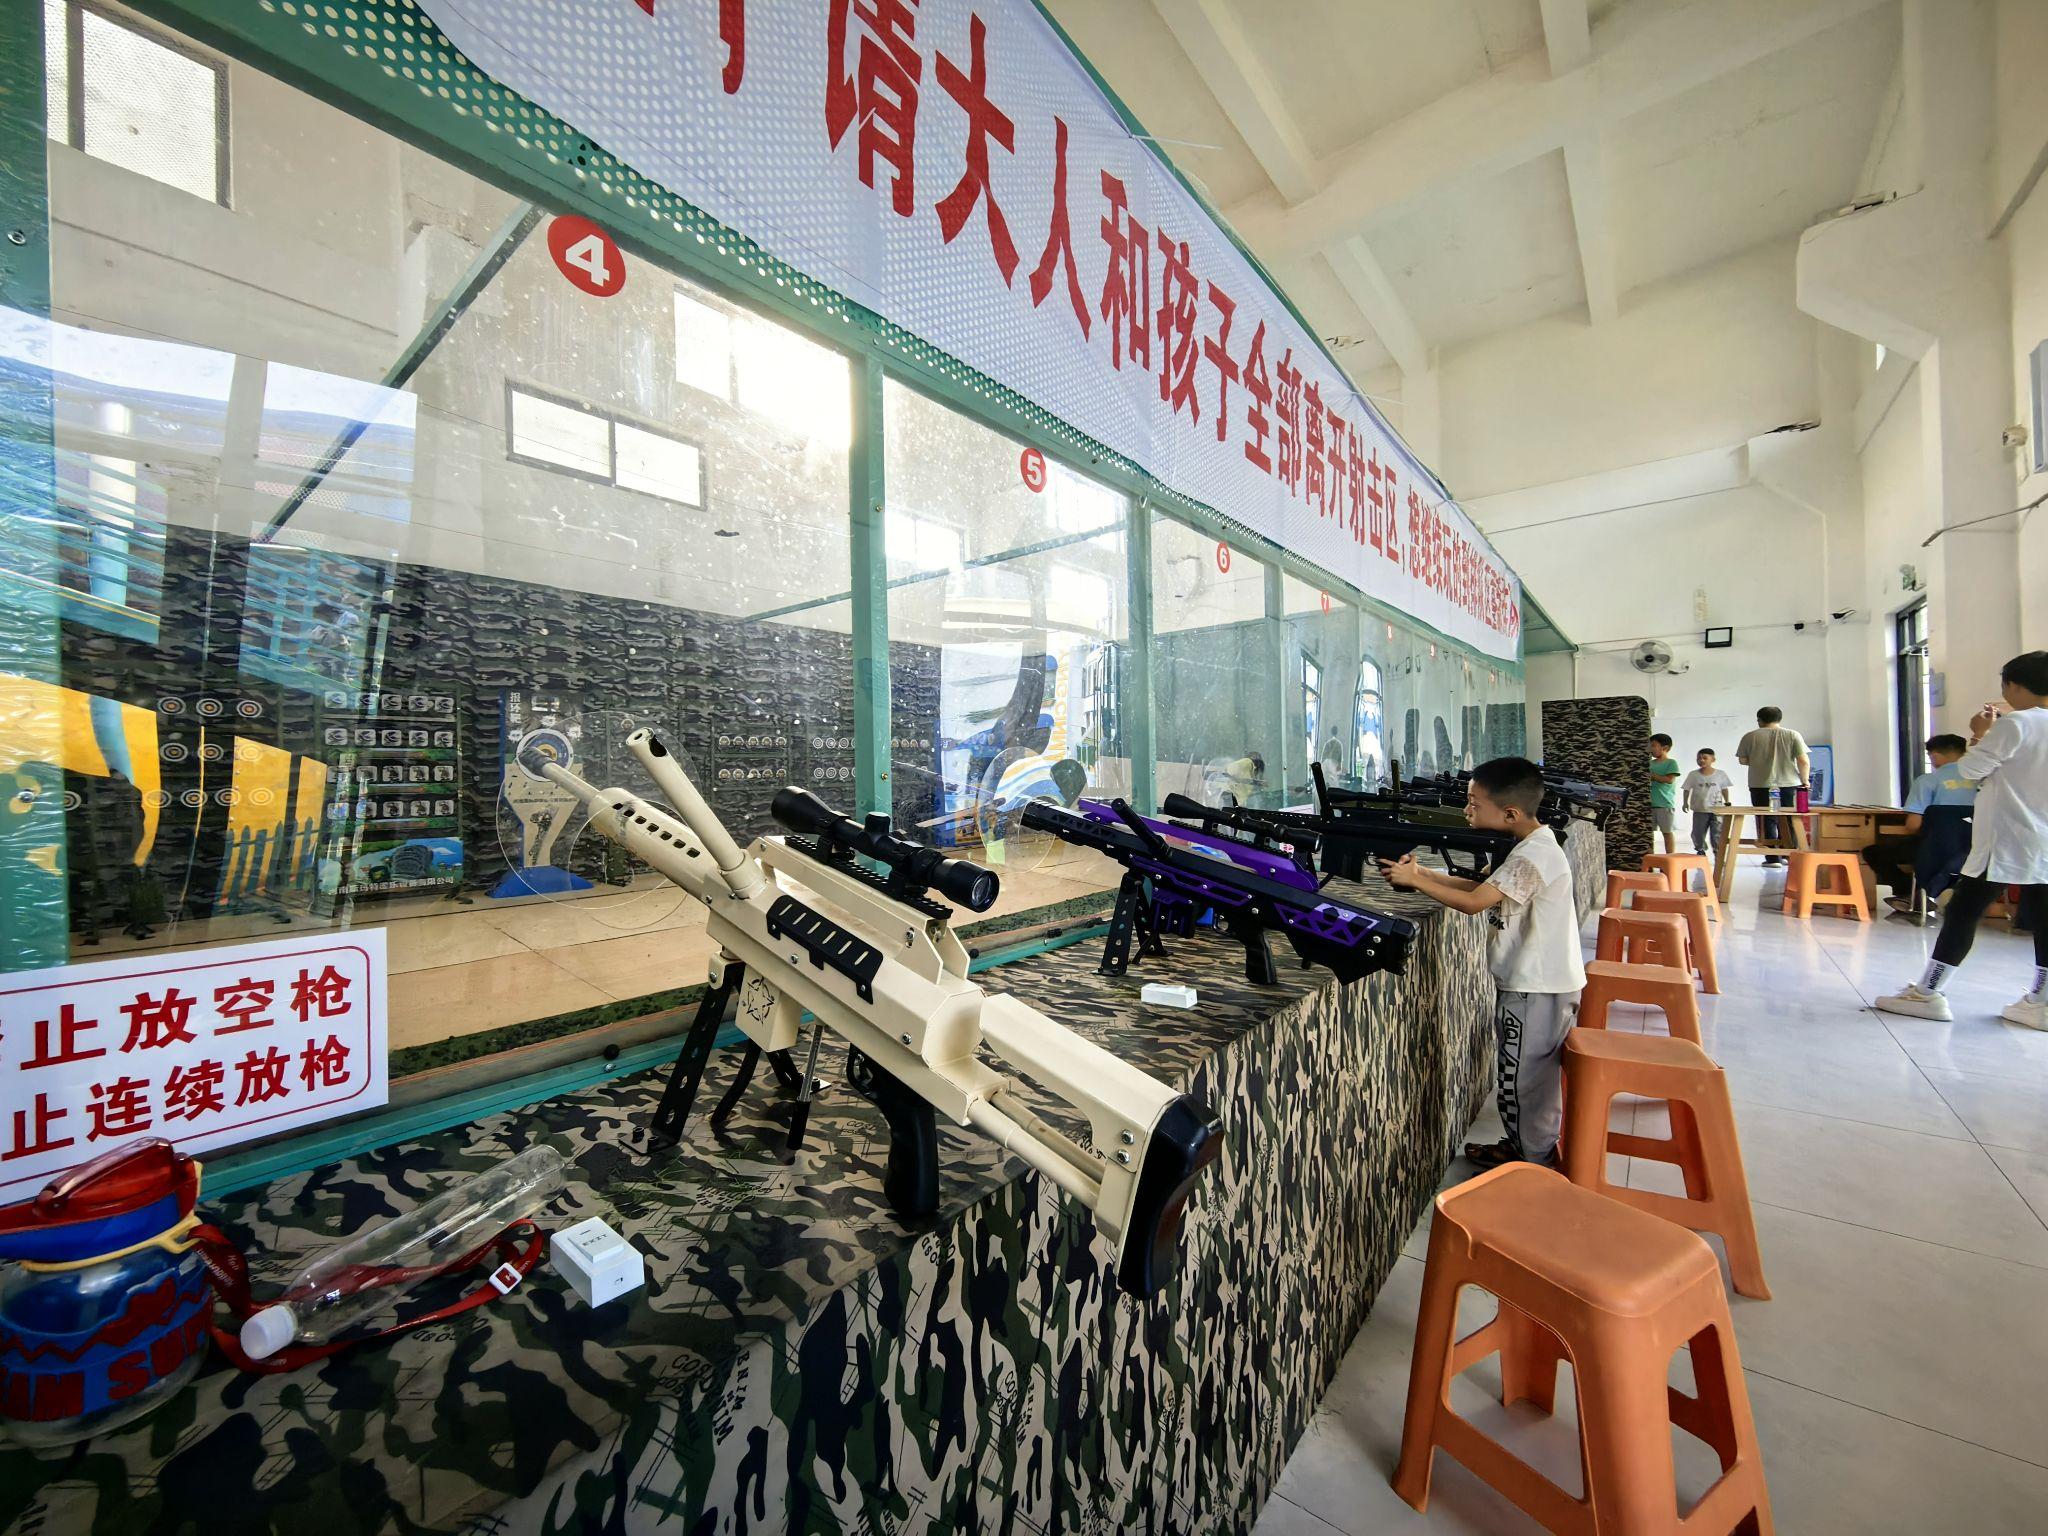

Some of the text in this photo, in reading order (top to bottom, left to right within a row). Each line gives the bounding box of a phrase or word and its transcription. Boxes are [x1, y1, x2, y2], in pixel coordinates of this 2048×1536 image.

[565, 234, 610, 287] 4
[1027, 454, 1043, 486] 5
[1219, 549, 1228, 571] 6
[0, 964, 353, 1072] 止放空枪
[1505, 1016, 1519, 1046] TOP
[1, 1034, 351, 1162] 止连续放枪
[582, 1233, 608, 1247] EXIT
